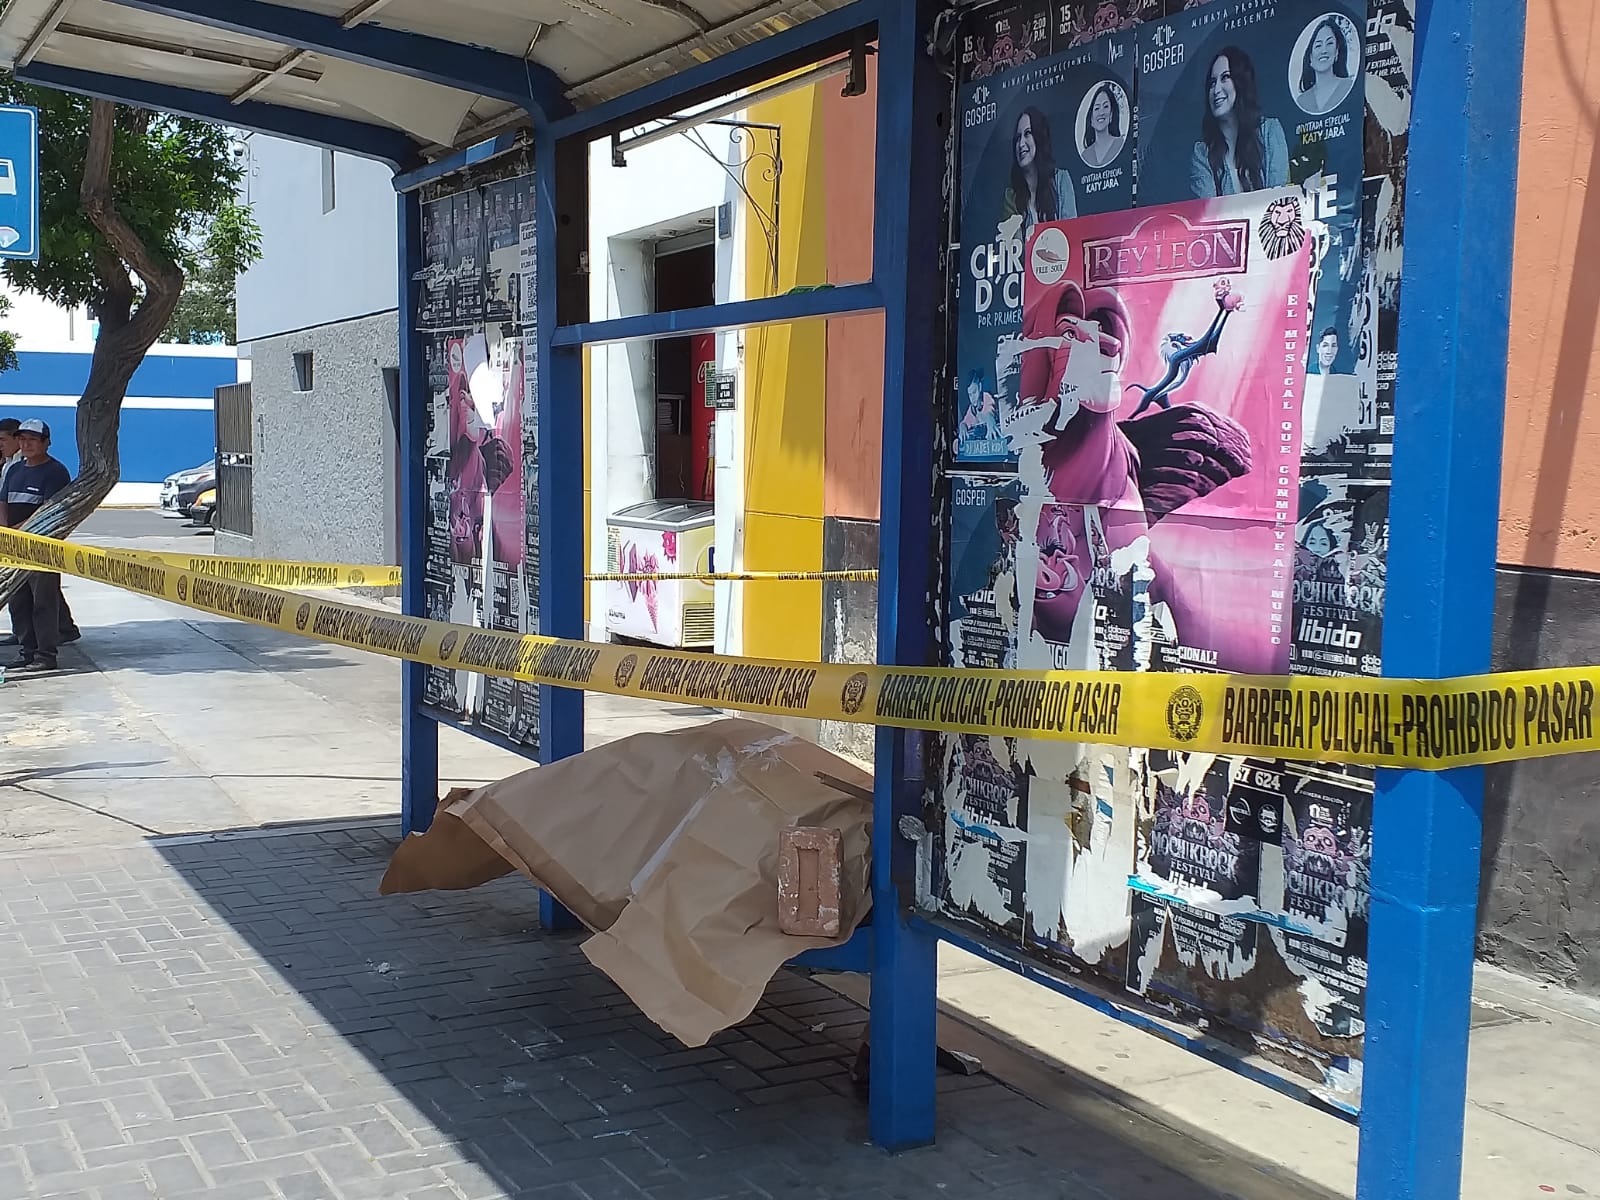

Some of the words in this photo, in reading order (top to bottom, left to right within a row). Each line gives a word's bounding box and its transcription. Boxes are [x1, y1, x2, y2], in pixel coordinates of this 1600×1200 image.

[1060, 5, 1071, 22] 15
[1224, 8, 1275, 31] PRESENTA
[1060, 21, 1072, 35] OCT
[964, 36, 973, 52] 15
[962, 51, 973, 63] OCT
[1143, 44, 1184, 74] GOSPER
[1026, 74, 1065, 94] PRESENTA
[965, 102, 997, 128] GOSPER
[1302, 131, 1322, 145] KATY
[1323, 126, 1346, 141] JARA
[1086, 181, 1102, 194] KATY
[1102, 178, 1119, 190] JARA
[1154, 230, 1166, 241] EL
[1094, 245, 1149, 277] REY
[1154, 229, 1242, 272] LEÓN
[1050, 264, 1064, 273] SOUL
[1286, 294, 1299, 318] EL
[978, 312, 992, 329] POR
[1281, 329, 1298, 410] MUSICAL
[1279, 421, 1293, 454] QUE
[955, 490, 986, 506] GOSPER
[1272, 558, 1284, 578] AL
[1270, 590, 1285, 645] MUNDO
[1302, 605, 1359, 622] FESTIVAL
[312, 605, 344, 640] BARRERA
[399, 620, 428, 656] PASAR
[1298, 617, 1362, 649] libido
[458, 632, 501, 669] BARRERA
[565, 644, 601, 683] PASAR
[639, 655, 688, 694] BARRERA
[774, 666, 817, 709] PASAR
[875, 673, 938, 719] BARRERA
[929, 675, 1070, 732] POLICIAL-PROHIBIDO
[1069, 682, 1122, 736] PASAR
[1222, 687, 1305, 749] BARRERA
[1307, 687, 1516, 759] POLICIAL-PROHIBIDO
[1523, 679, 1594, 748] PASAR
[1254, 771, 1281, 791] 624
[1151, 830, 1241, 886] MOCHIKROCK
[1170, 858, 1218, 883] FESTIVAL
